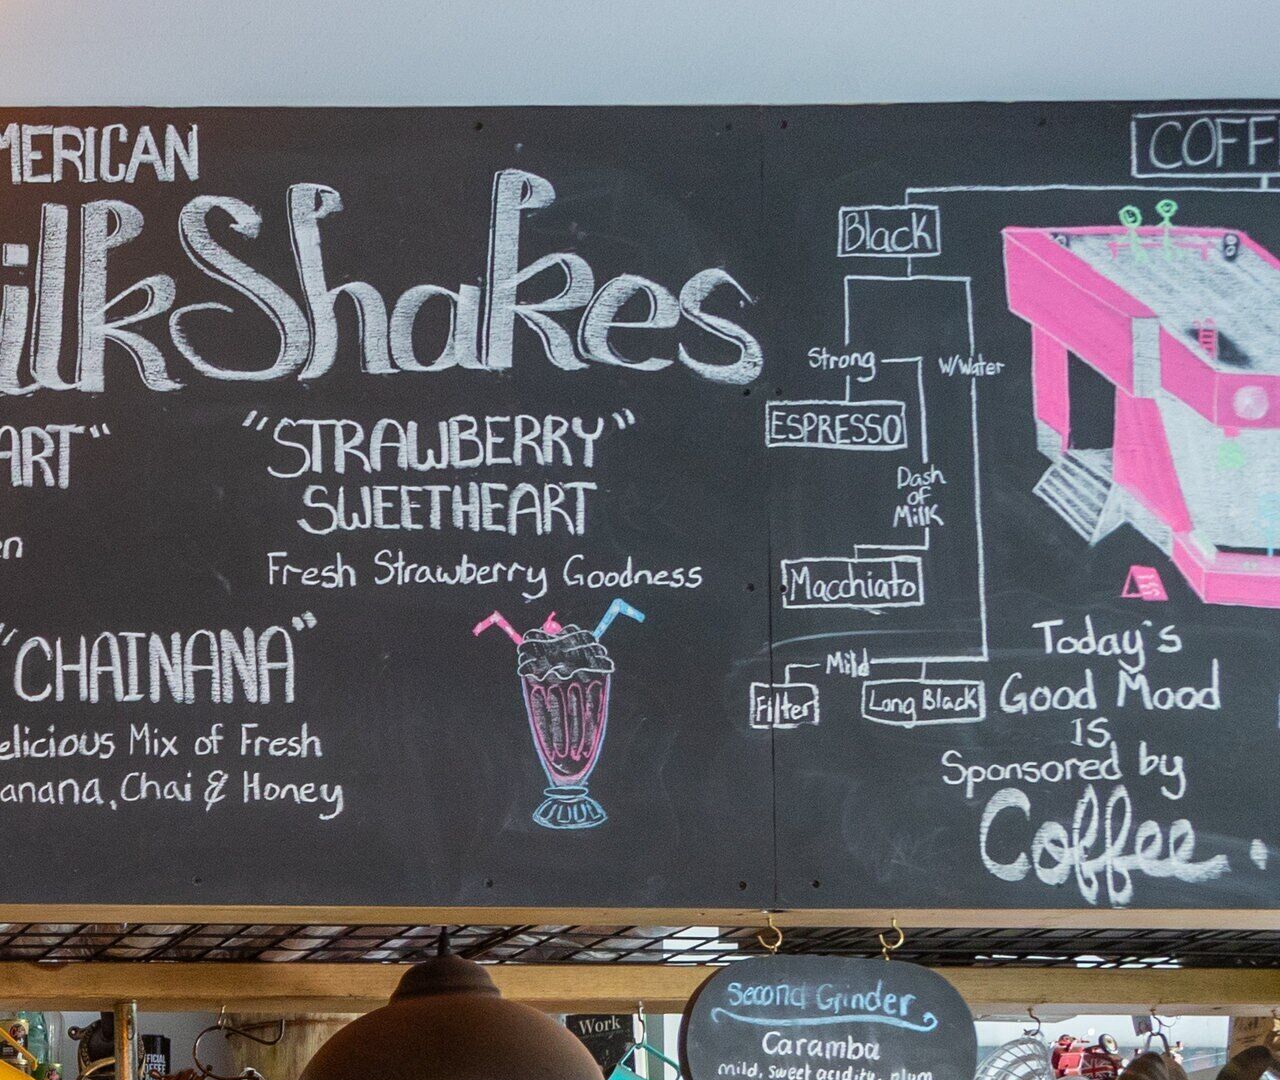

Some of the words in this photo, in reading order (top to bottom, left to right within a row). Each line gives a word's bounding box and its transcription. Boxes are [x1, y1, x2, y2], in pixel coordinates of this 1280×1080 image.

[1149, 117, 1280, 168] COFF
[844, 212, 936, 253] Black
[808, 347, 876, 382] Strong
[770, 411, 904, 446] ESPRESSO
[297, 482, 597, 535] SWEETHEART
[267, 552, 356, 588] Fresh
[374, 549, 547, 603] Strawberry
[563, 554, 702, 588] Goodness
[790, 562, 917, 599] Macchiato
[1032, 615, 1182, 674] Today's
[1000, 669, 1097, 714] Good
[1117, 650, 1221, 710] Mood
[756, 692, 816, 724] Filter
[869, 691, 915, 720] Long
[922, 687, 980, 710] Black
[941, 741, 1122, 806] Sponsored
[1139, 741, 1186, 800] by
[727, 981, 805, 1008] Second
[817, 982, 915, 1018] Grinder
[579, 1015, 620, 1035] Work
[762, 1031, 880, 1060] Caramba
